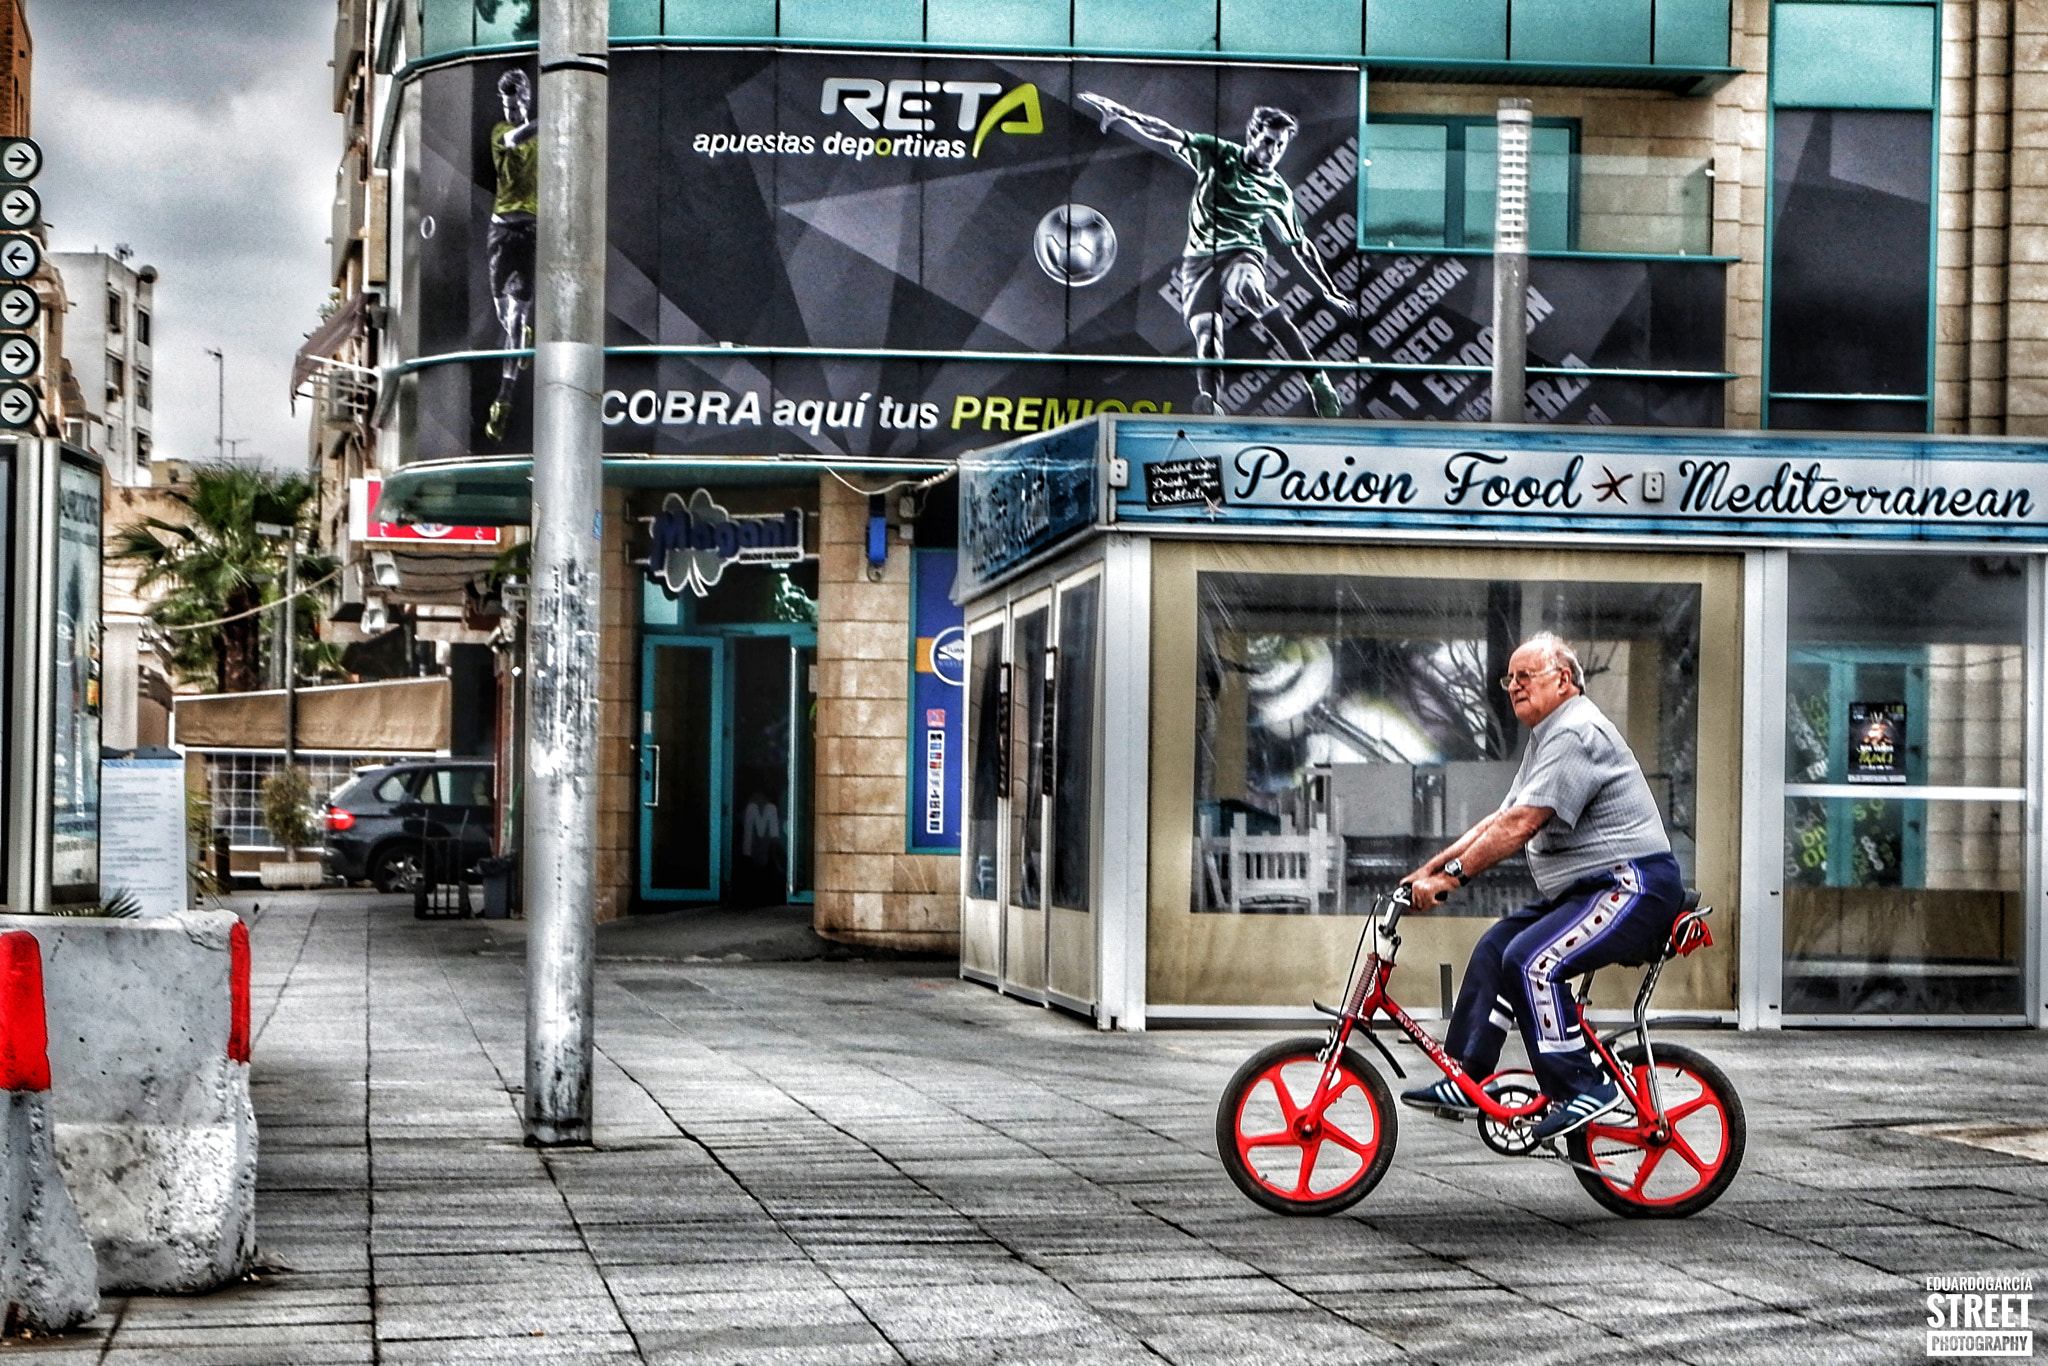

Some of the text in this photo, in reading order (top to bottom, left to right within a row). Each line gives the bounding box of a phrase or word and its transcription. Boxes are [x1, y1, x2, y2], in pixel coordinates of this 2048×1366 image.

[693, 131, 967, 161] apuestas deportivas
[820, 77, 1044, 158] RETA
[1367, 256, 1469, 349] DIVERSIÓN
[602, 389, 761, 426] COBRA
[772, 391, 871, 436] aquí
[879, 396, 940, 430] tus
[1234, 445, 2036, 517] Pasion Food Mediterranean
